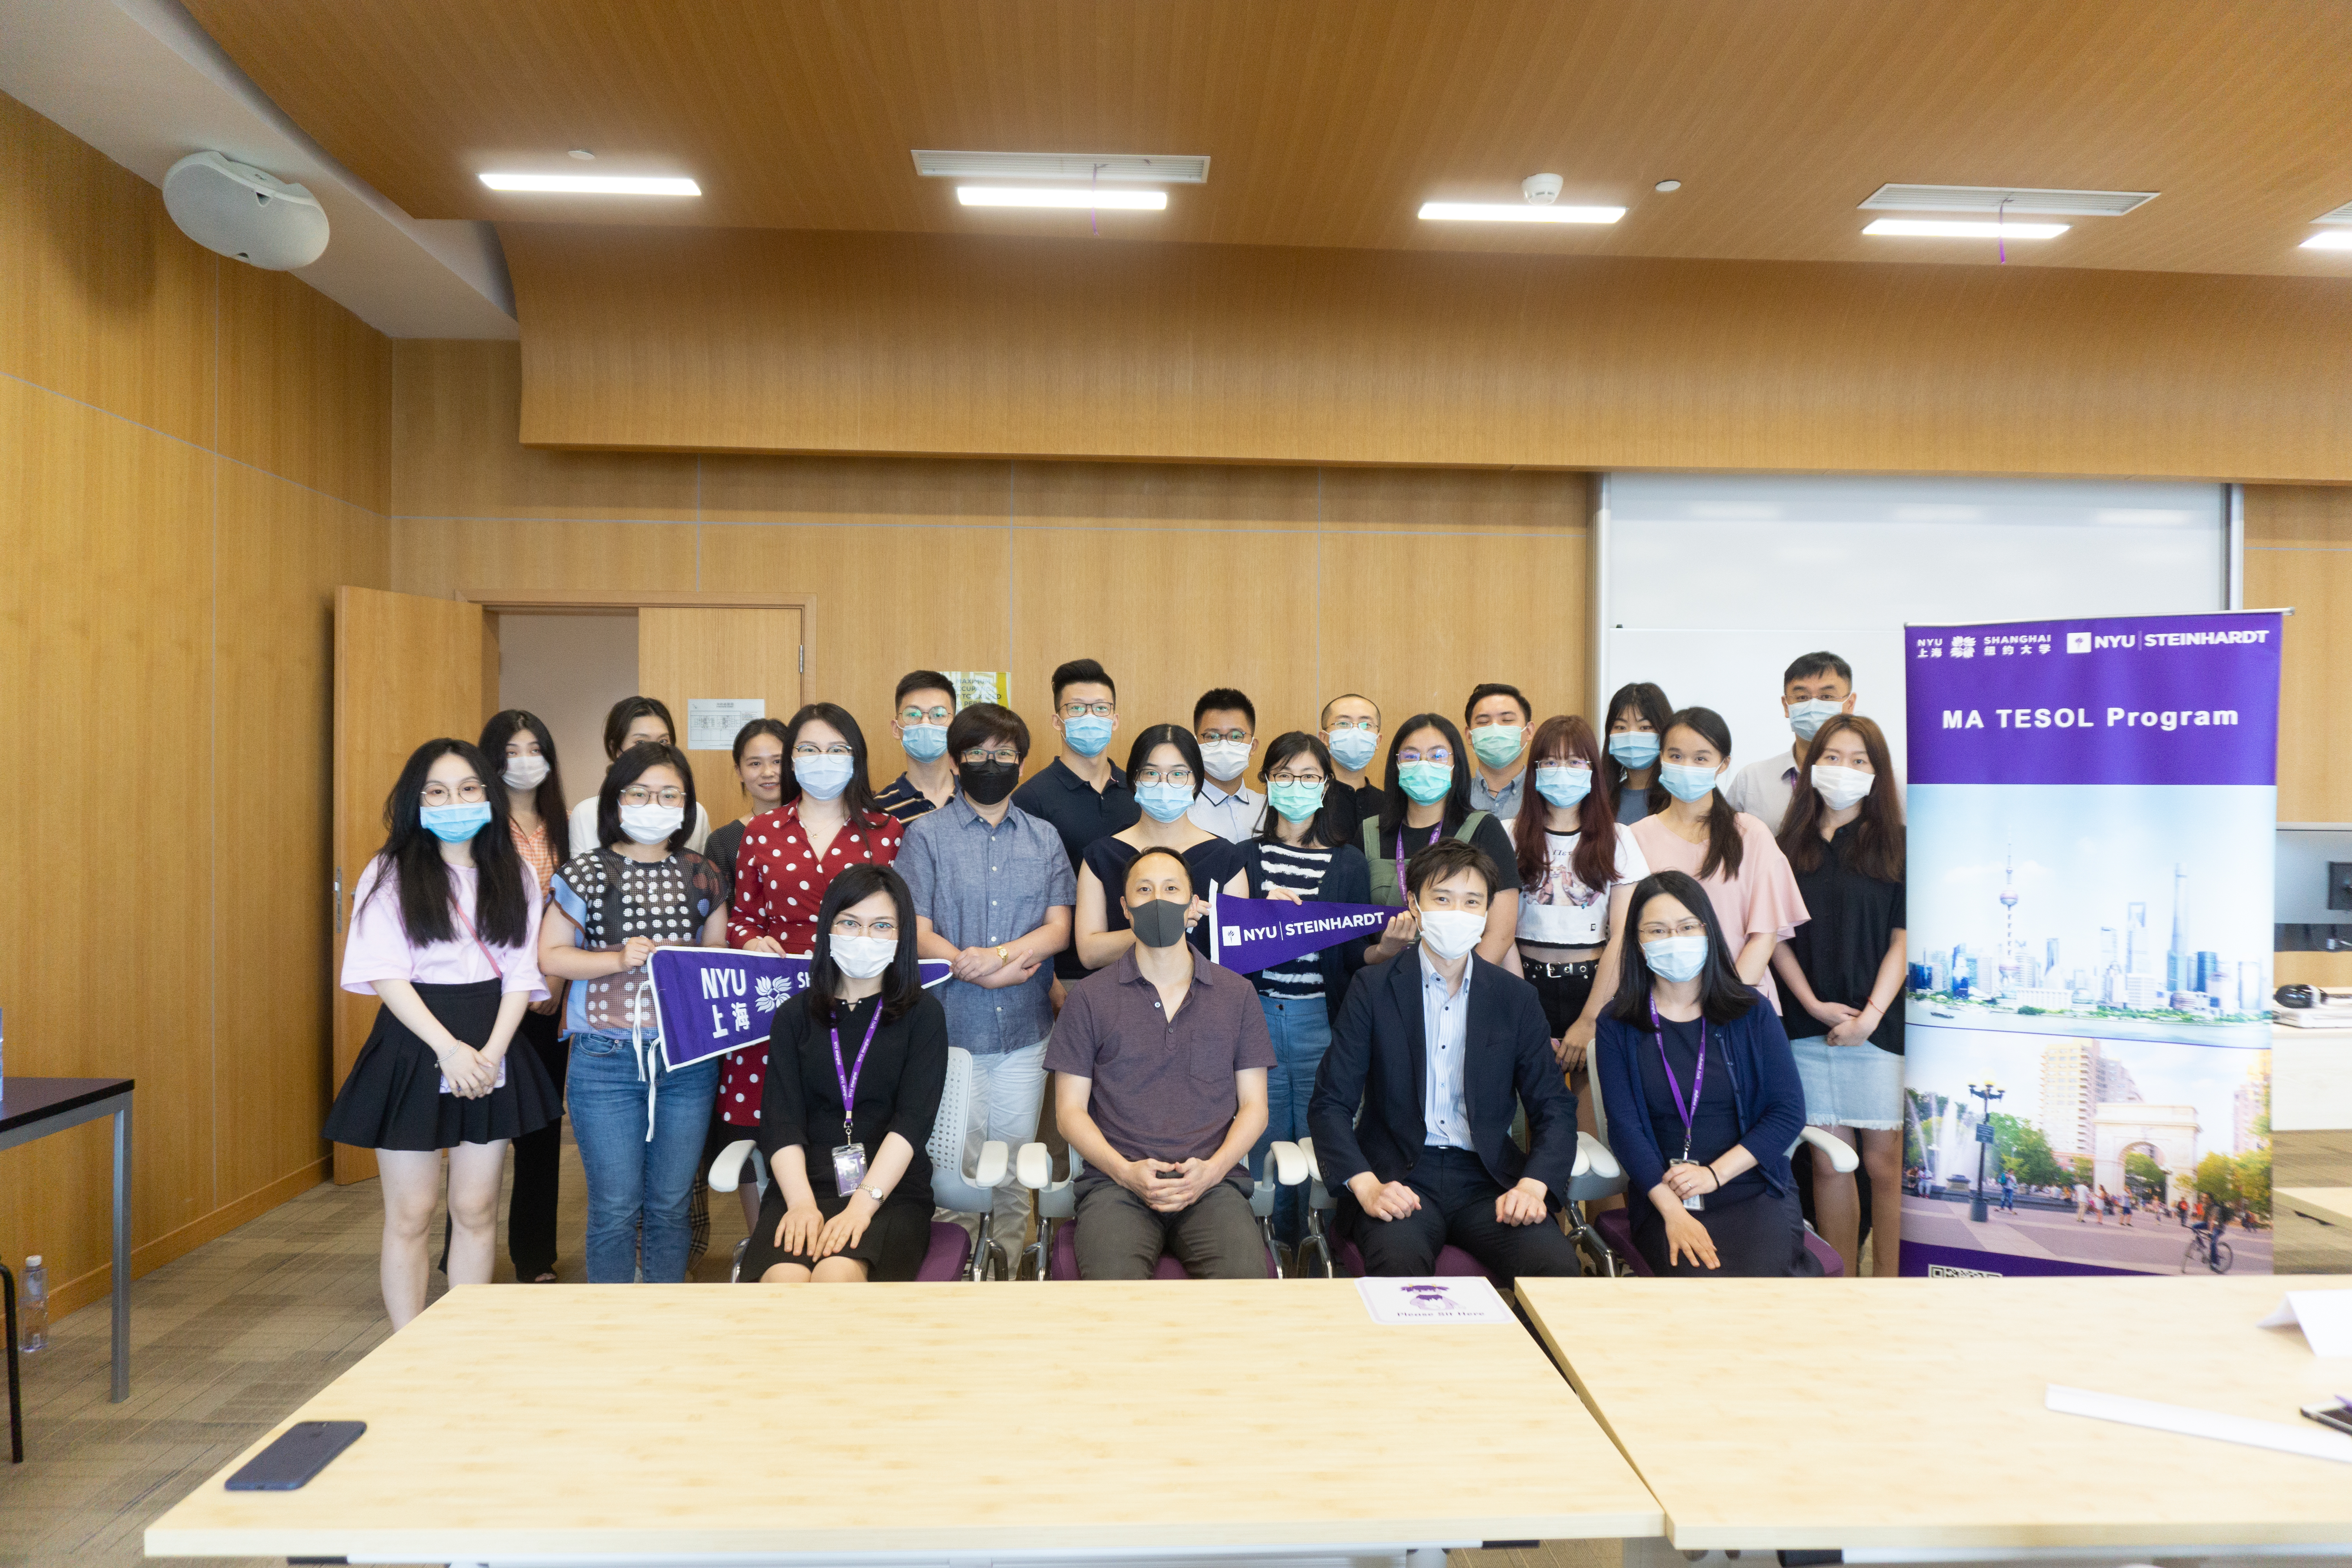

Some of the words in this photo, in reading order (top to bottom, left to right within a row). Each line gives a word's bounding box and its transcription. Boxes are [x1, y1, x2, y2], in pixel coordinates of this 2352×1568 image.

[1917, 638, 1943, 646] NYU
[1984, 635, 2051, 644] SHANGHAI
[2094, 635, 2135, 648] NYU
[2144, 630, 2269, 646] STEINHARDT
[1918, 648, 1942, 658] 上海
[1942, 710, 1984, 728] MA
[1996, 708, 2094, 728] TESOL
[2107, 707, 2238, 731] Program
[1244, 926, 1277, 941] NYU
[1285, 912, 1384, 936] STEINHARDT
[701, 968, 746, 999] NYU
[712, 1002, 750, 1038] 上海
